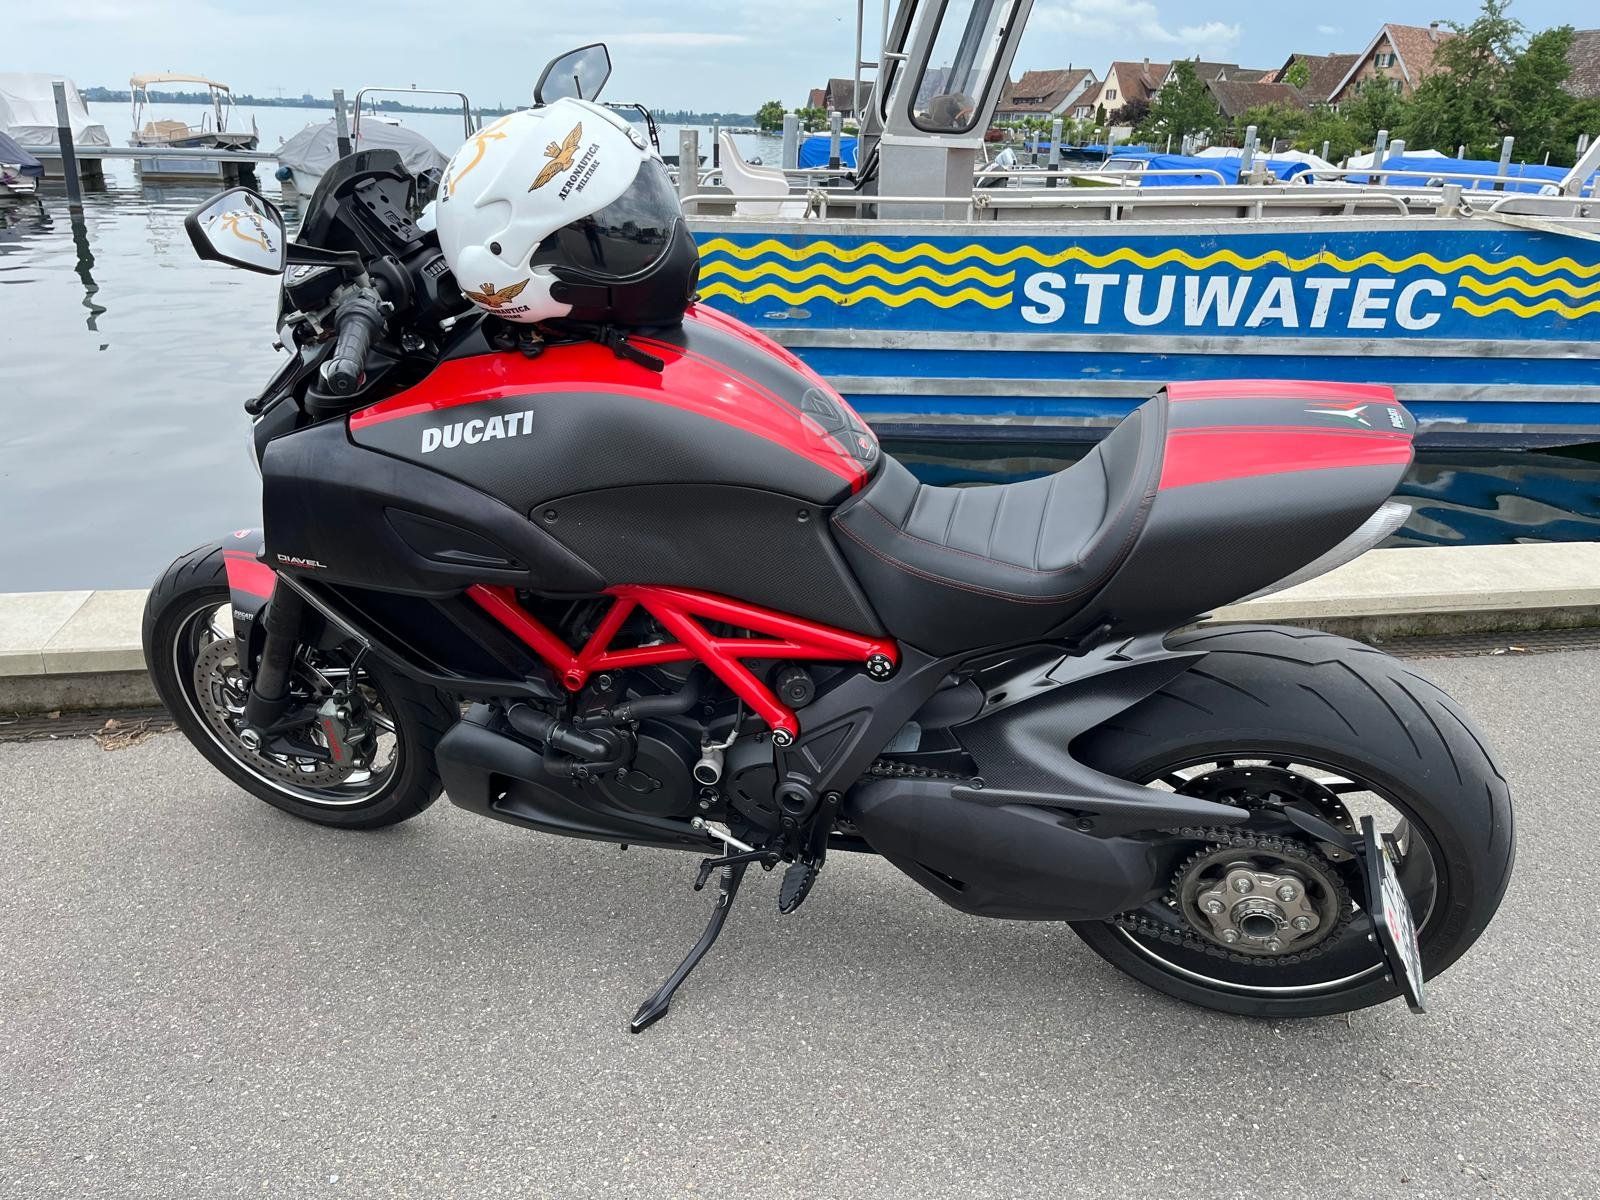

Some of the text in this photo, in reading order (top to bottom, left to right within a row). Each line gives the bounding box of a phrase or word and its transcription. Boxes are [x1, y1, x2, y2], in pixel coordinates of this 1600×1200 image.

[559, 143, 600, 200] AERONAUTICA
[575, 159, 600, 192] MILITARE
[1020, 272, 1447, 330] STUWATEC
[421, 410, 534, 453] DUCATI
[277, 553, 328, 569] DIAVEL
